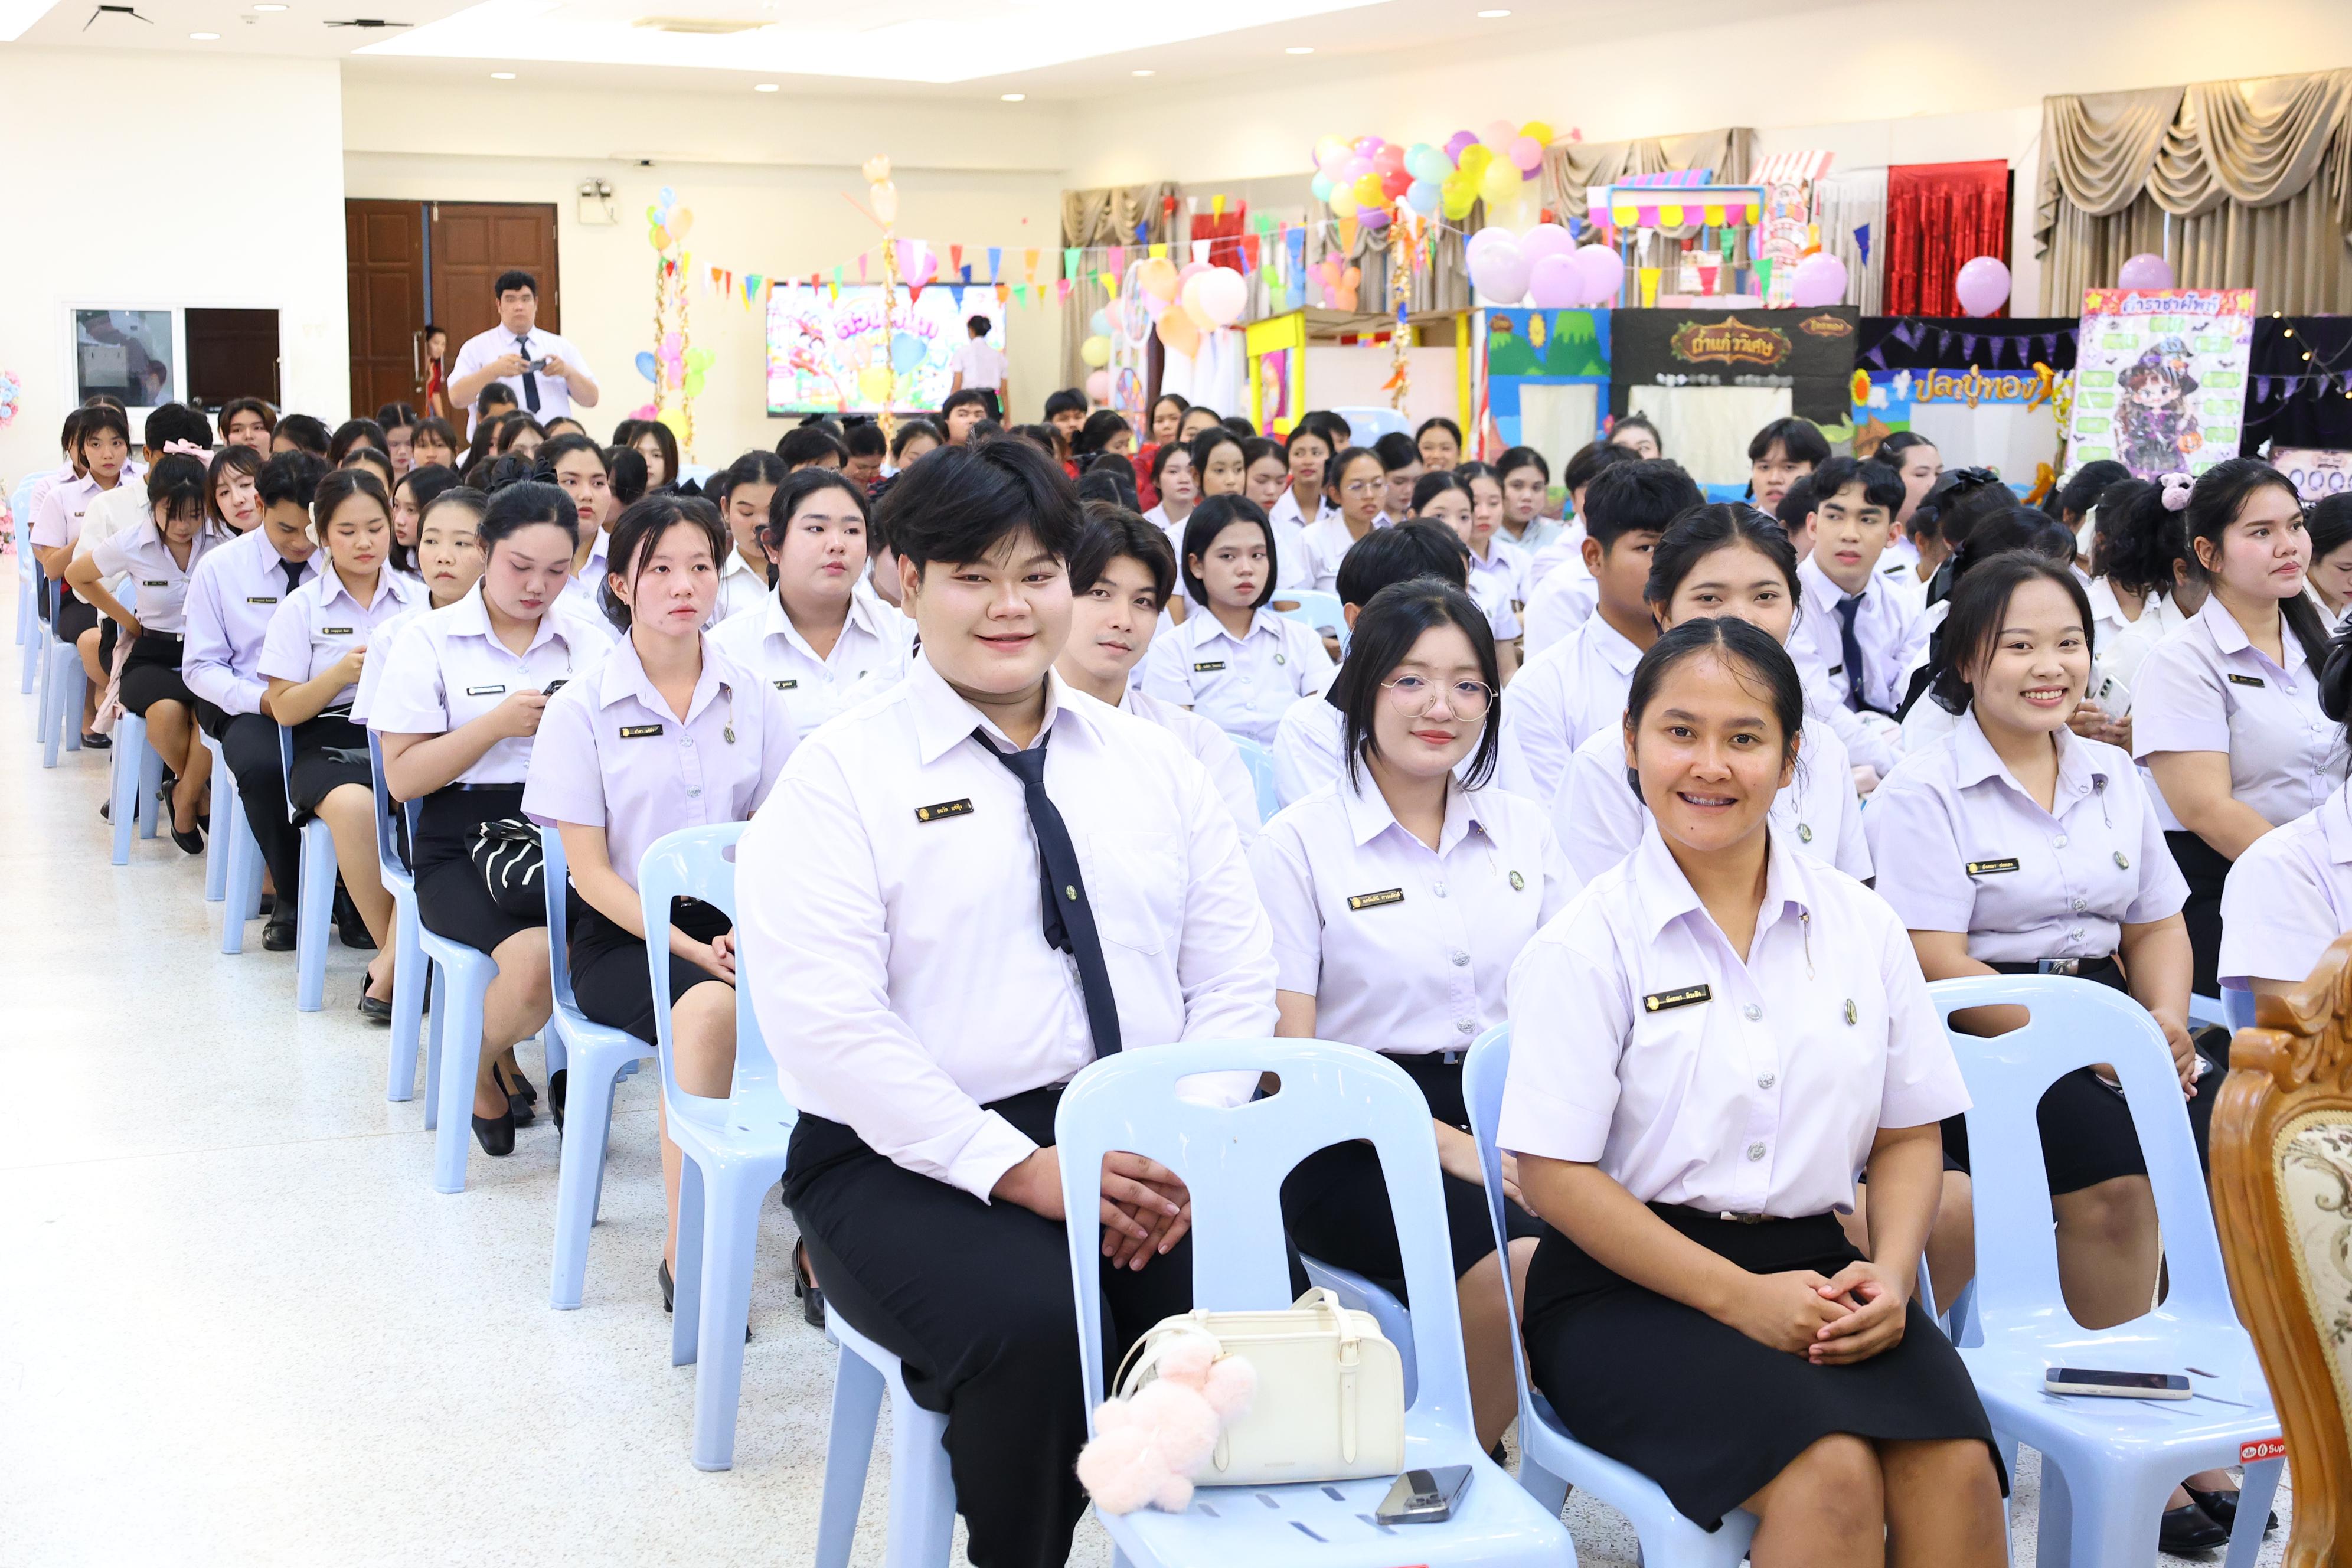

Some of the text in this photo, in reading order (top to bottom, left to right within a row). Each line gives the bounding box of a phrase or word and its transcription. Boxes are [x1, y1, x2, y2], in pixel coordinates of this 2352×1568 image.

[1915, 364, 2039, 409] ปลาบู่ทอง
[2269, 1443, 2286, 1453] Sup
